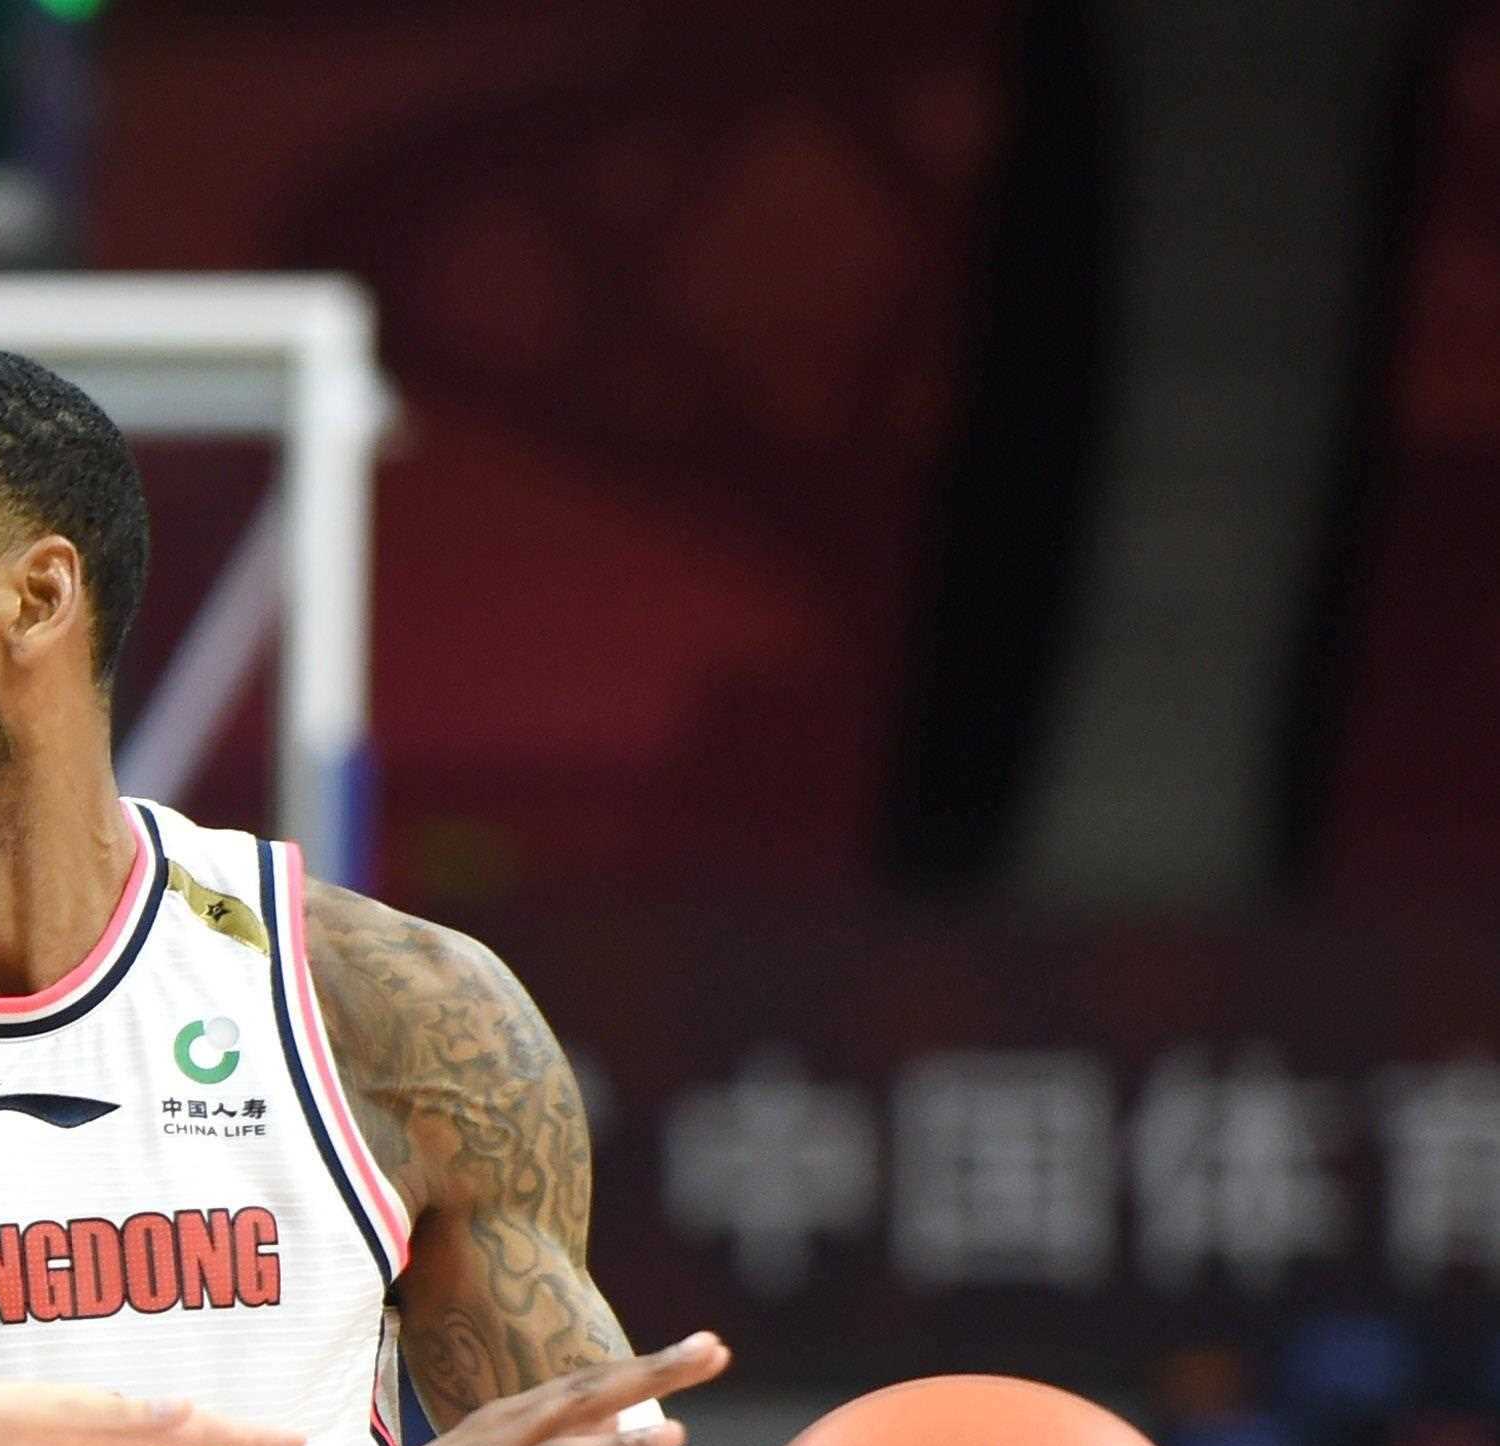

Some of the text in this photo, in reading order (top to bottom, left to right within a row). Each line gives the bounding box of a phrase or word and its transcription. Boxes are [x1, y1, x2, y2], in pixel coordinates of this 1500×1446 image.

[161, 1096, 267, 1119] 中国人寿
[163, 1123, 267, 1138] CHINA LIFE
